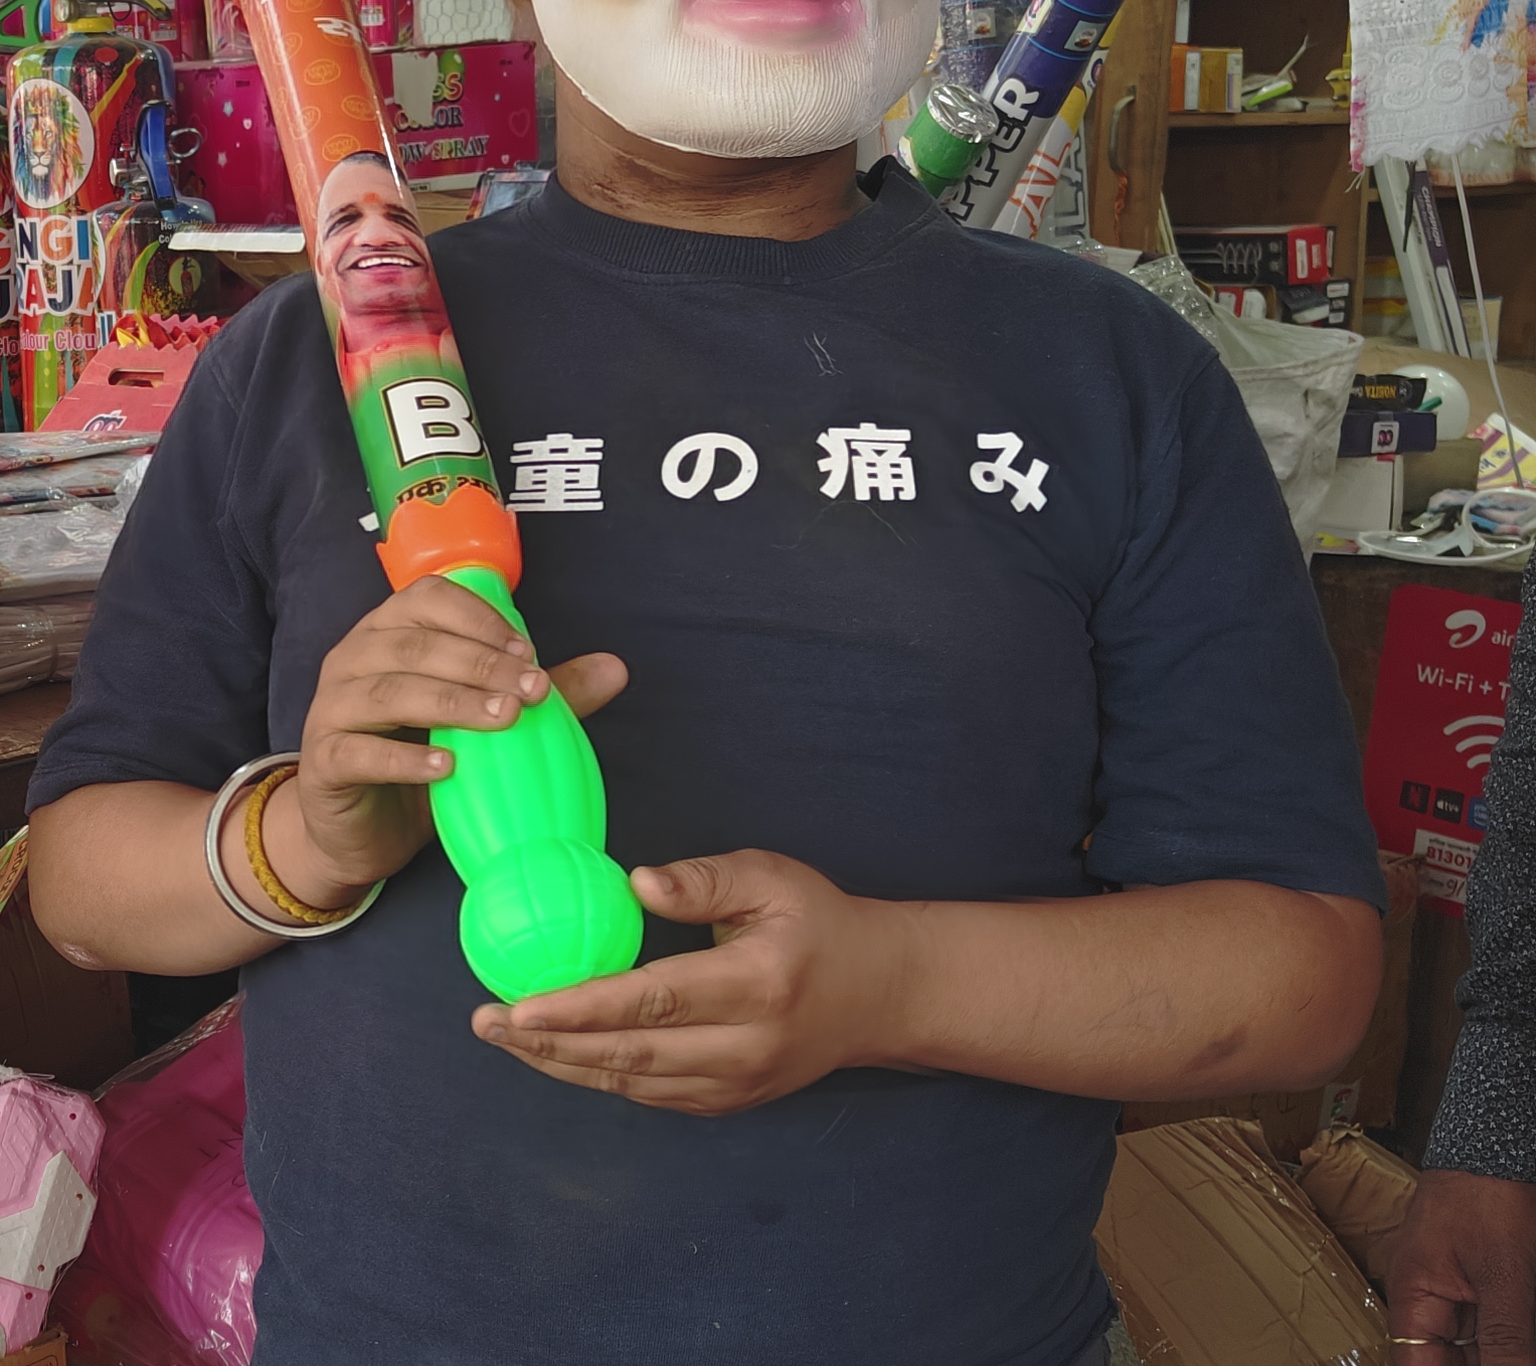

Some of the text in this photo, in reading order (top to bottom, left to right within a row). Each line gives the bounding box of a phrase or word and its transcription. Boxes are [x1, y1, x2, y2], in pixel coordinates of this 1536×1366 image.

[395, 105, 463, 133] COR
[431, 135, 490, 161] SPRAY
[1417, 663, 1475, 693] Wi-Fi
